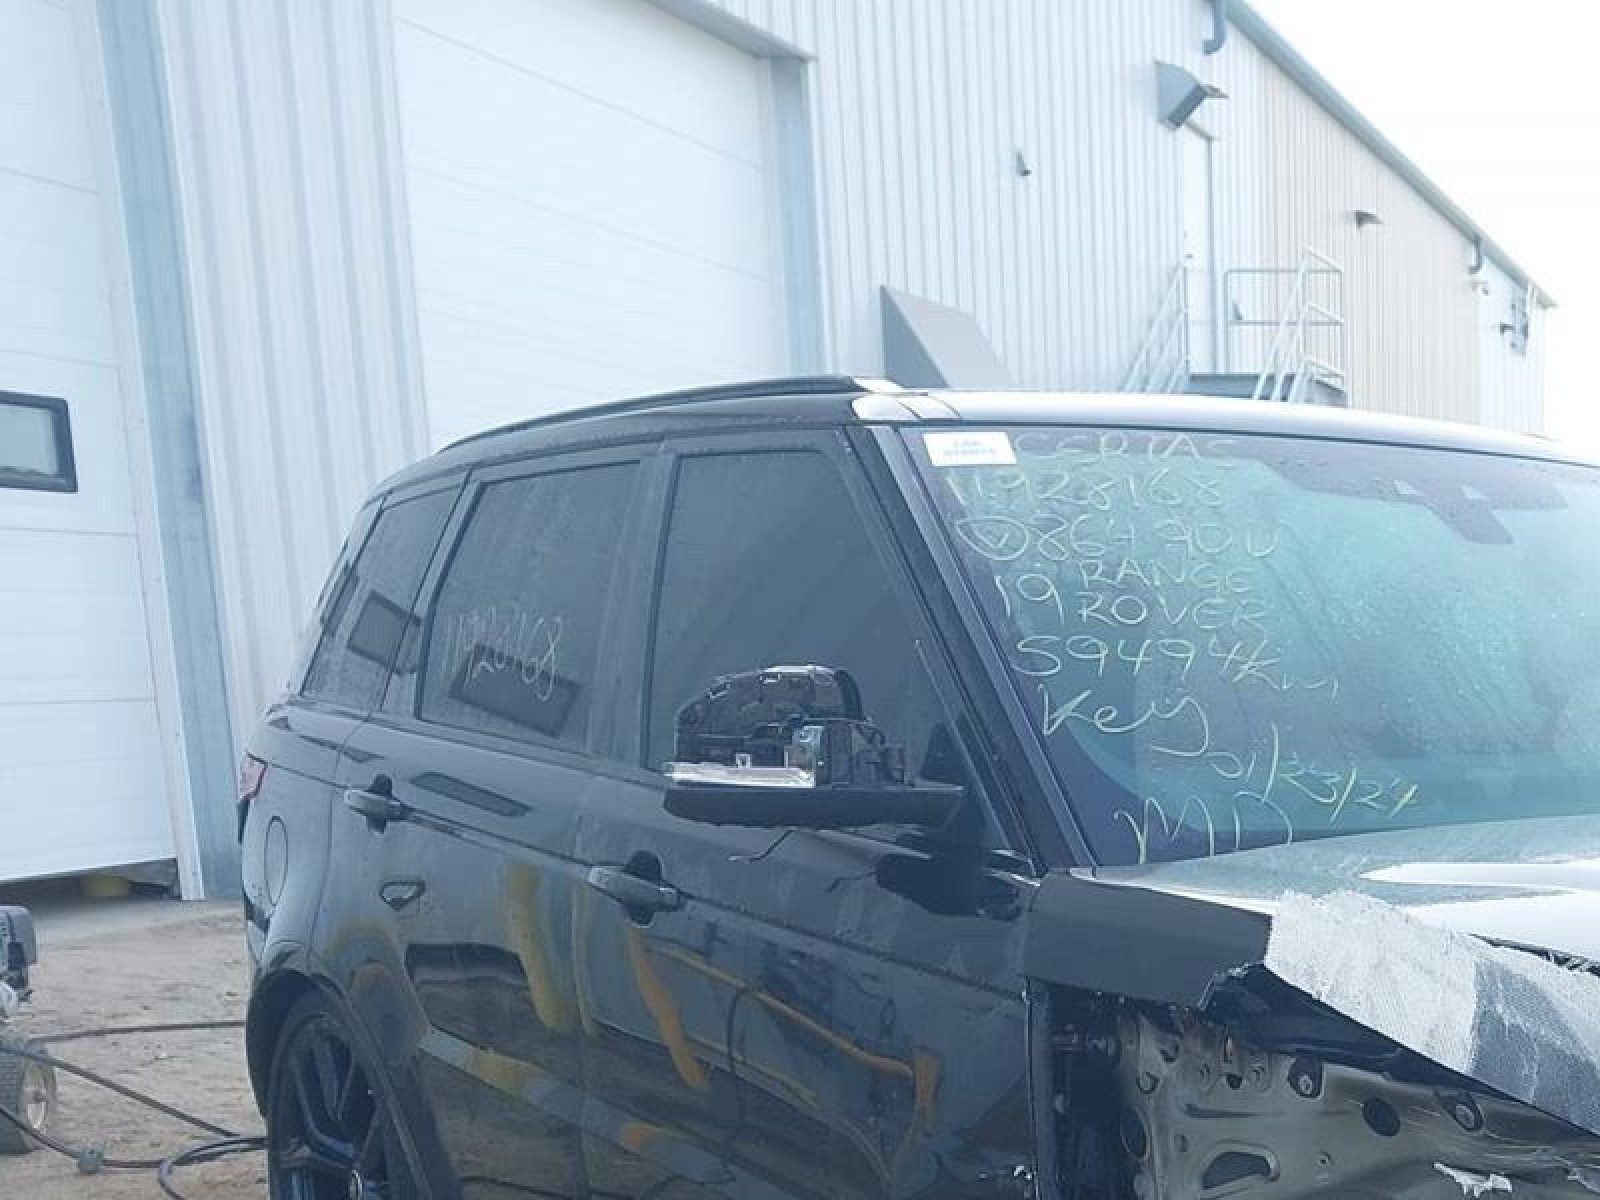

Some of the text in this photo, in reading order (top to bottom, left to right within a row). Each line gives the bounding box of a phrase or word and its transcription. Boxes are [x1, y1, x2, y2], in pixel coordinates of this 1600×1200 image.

[1078, 559, 1254, 593] RANGE
[995, 573, 1065, 623] 19
[1075, 591, 1268, 628] ROVER
[1037, 684, 1209, 757] Key
